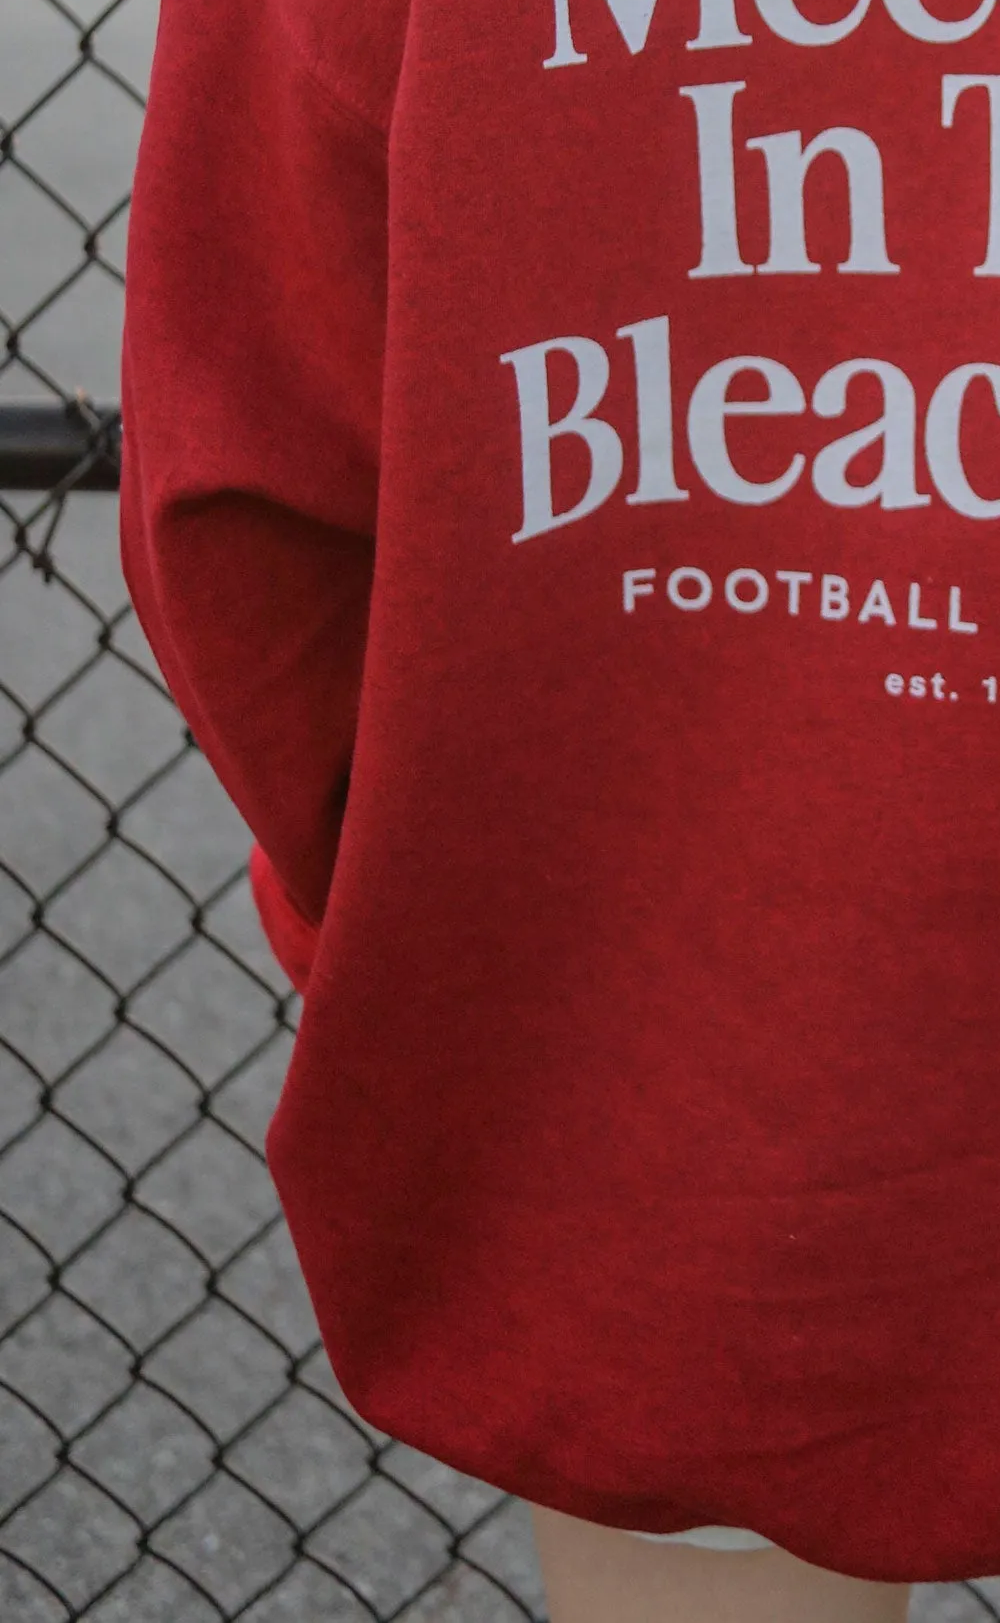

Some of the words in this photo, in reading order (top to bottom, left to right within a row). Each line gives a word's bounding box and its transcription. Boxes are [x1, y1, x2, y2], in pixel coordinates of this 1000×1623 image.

[679, 81, 901, 279] In
[622, 566, 979, 634] FOOTBALL
[885, 672, 959, 699] est.
